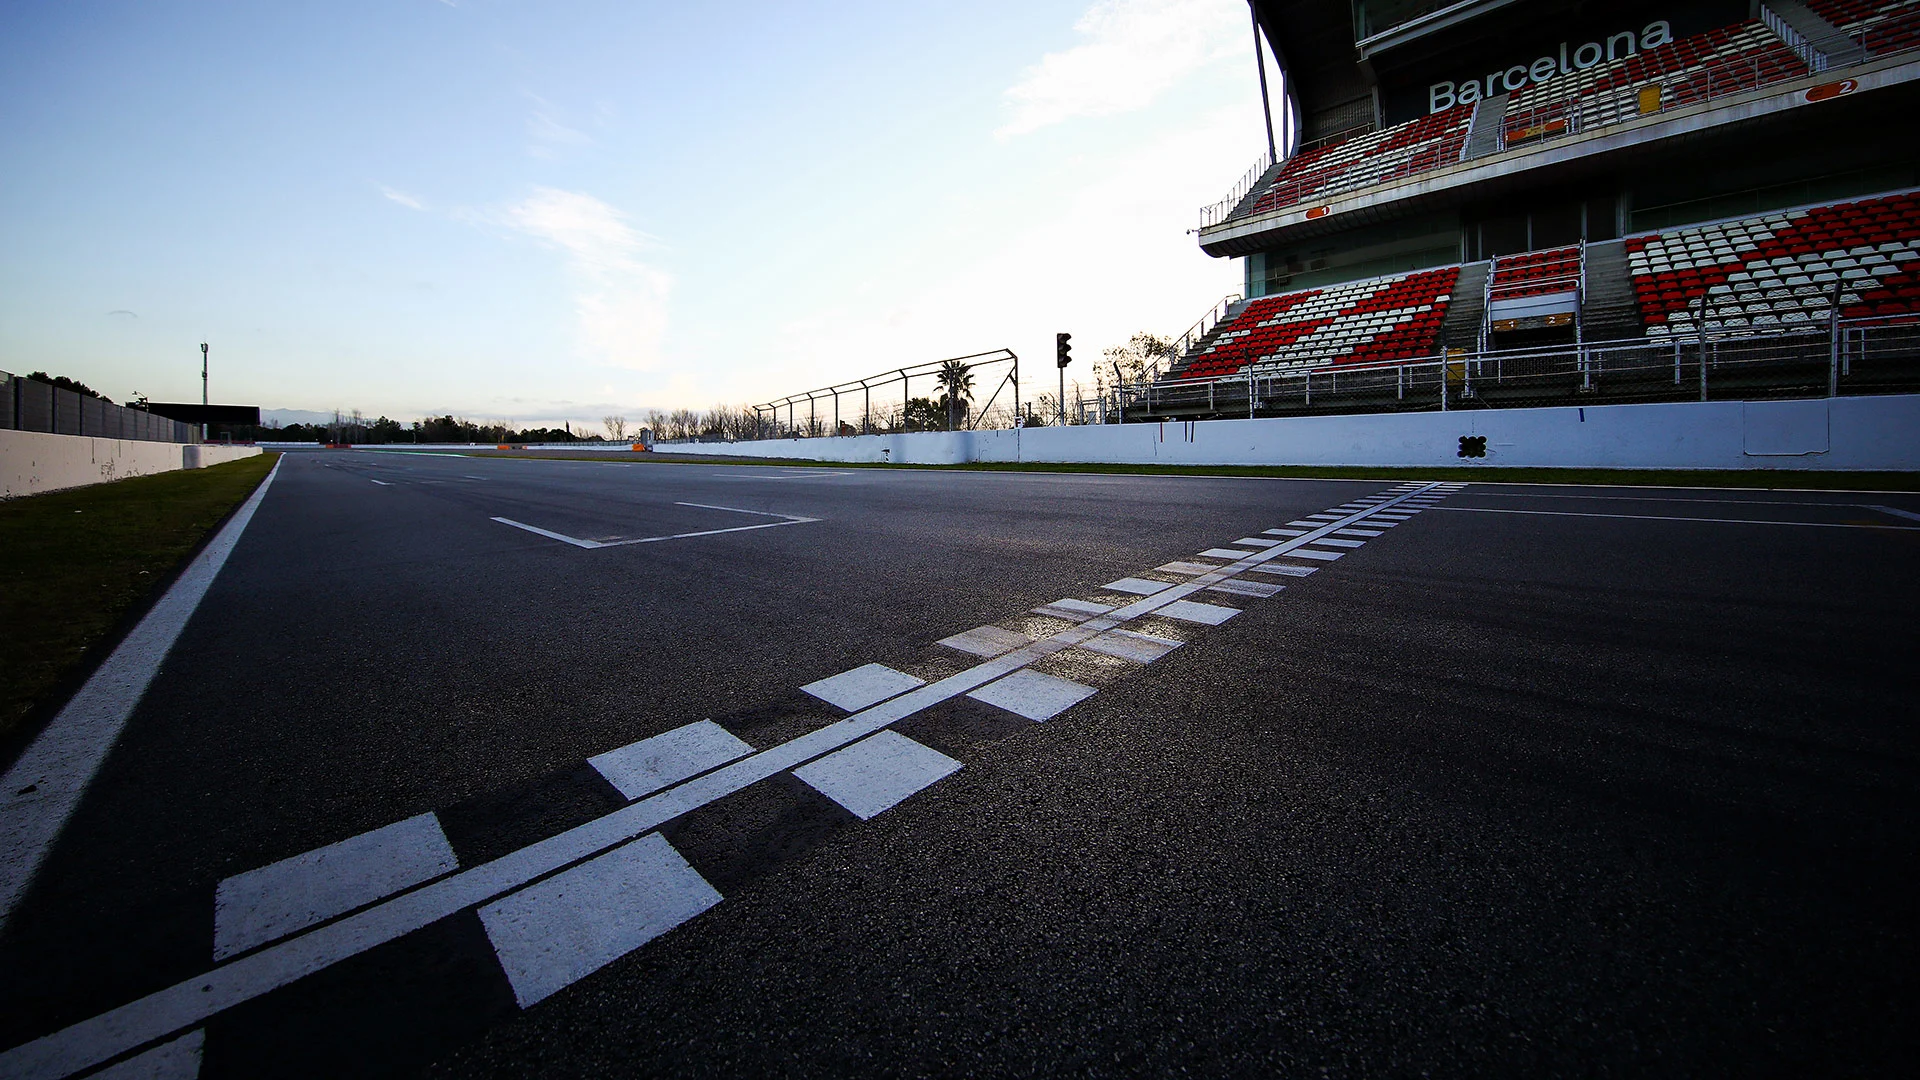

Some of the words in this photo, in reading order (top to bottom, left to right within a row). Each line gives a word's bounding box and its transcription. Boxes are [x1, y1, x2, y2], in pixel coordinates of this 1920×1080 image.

[1429, 20, 1674, 115] Barcelona
[1839, 81, 1853, 94] 2
[1321, 206, 1327, 215] 1
[1549, 316, 1556, 324] 2
